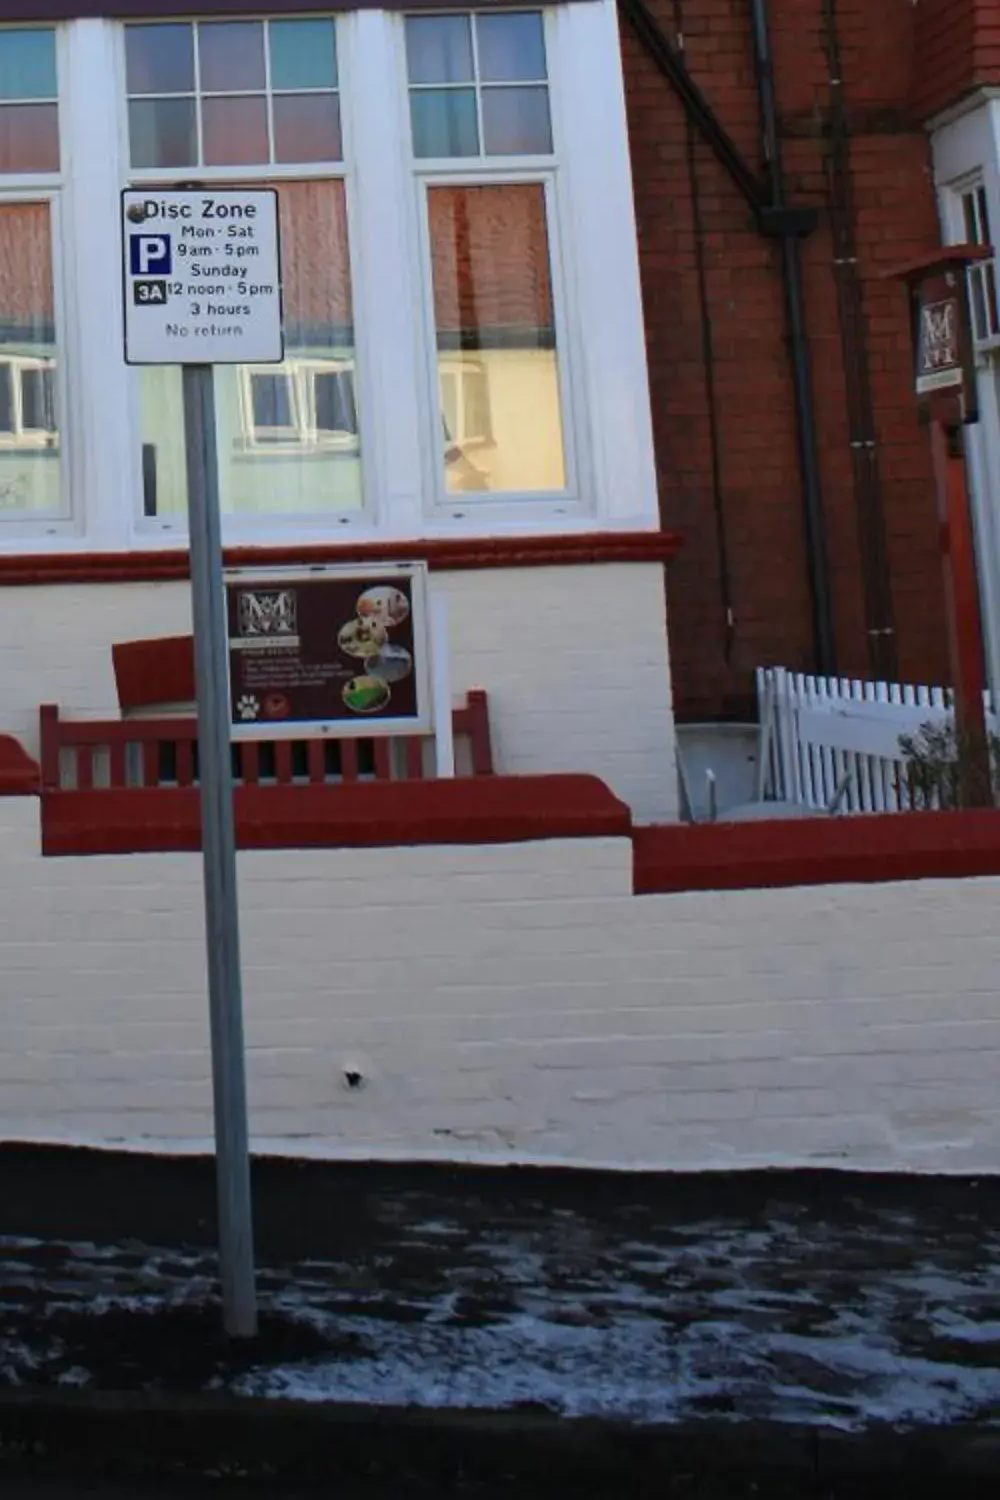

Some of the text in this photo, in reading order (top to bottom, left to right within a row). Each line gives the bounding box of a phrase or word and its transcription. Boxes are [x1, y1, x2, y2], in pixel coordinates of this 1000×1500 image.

[144, 200, 257, 219] Disc Zone
[227, 225, 253, 238] Sat
[139, 237, 167, 273] P
[191, 263, 248, 279] Sunday
[138, 284, 163, 301] 3A
[167, 282, 183, 295] 12
[187, 285, 225, 295] noon
[191, 303, 251, 316] 3 hours
[165, 323, 243, 337] No return
